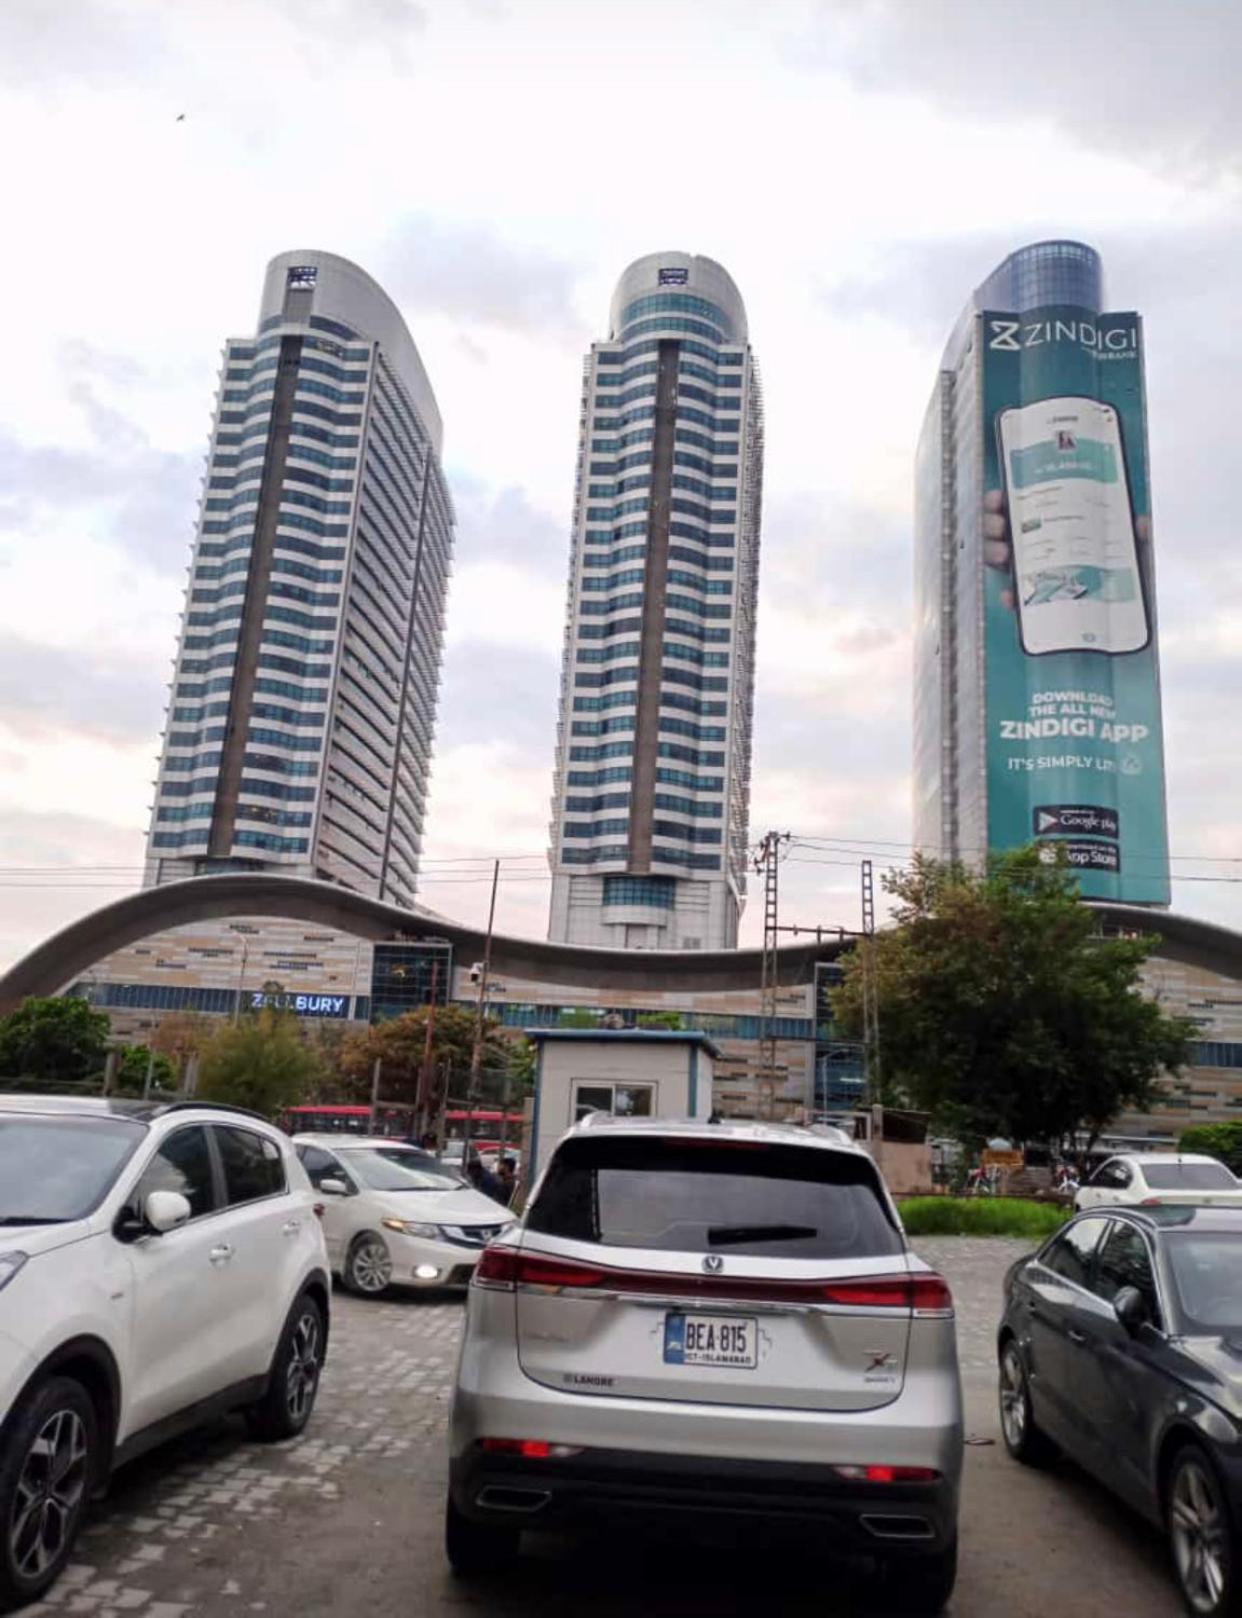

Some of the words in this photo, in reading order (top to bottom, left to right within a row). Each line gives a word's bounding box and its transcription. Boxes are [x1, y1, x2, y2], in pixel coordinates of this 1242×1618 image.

[1024, 320, 1136, 350] ZINDIGI
[1029, 704, 1056, 717] THE
[1060, 703, 1086, 715] ALL
[1000, 718, 1094, 739] ZINDIGI
[1100, 722, 1148, 742] APP
[1008, 757, 1034, 771] IT'S
[1037, 755, 1092, 769] SIMPLY
[1060, 814, 1099, 830] Google
[1090, 850, 1117, 867] Store
[686, 1323, 715, 1350] BEA
[720, 1325, 747, 1353] 815
